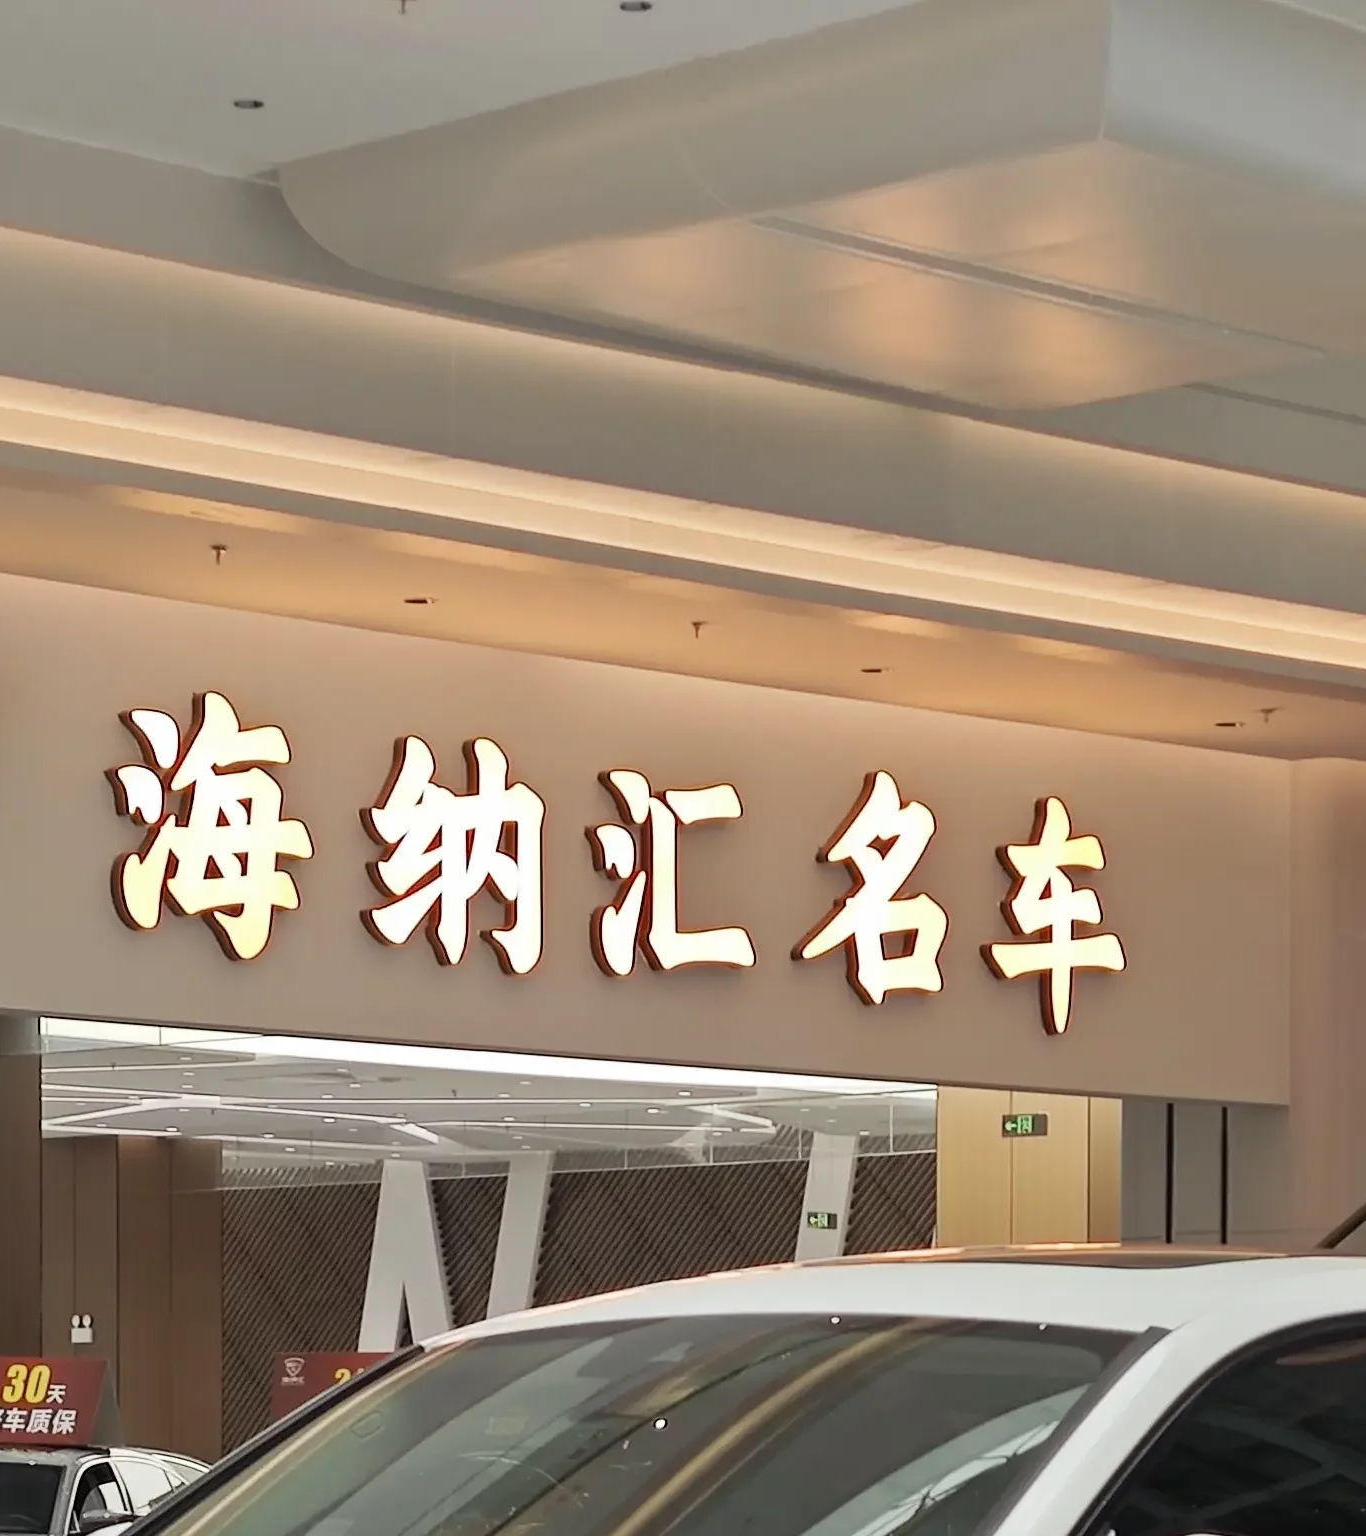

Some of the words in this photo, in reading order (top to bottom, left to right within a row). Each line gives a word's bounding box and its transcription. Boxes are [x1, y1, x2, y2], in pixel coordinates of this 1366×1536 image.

[107, 690, 1128, 1036] 海纳汇名车
[2, 1363, 67, 1404] 30天
